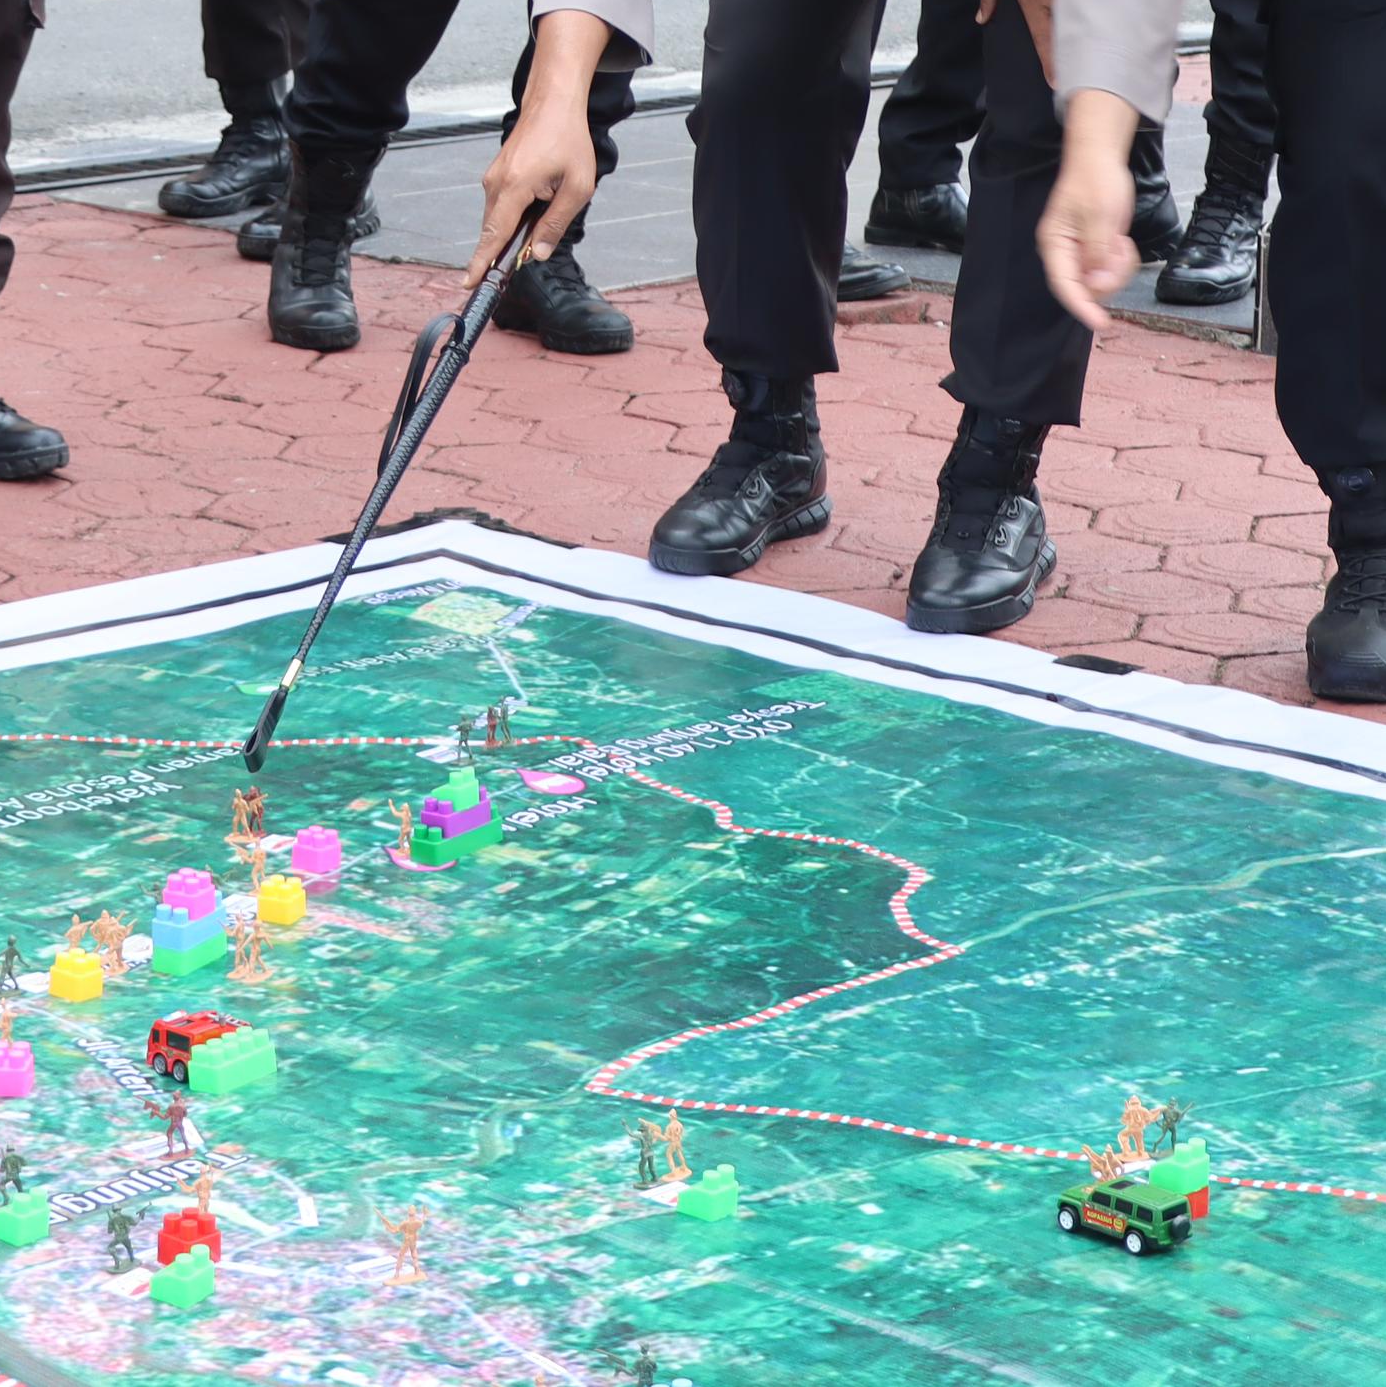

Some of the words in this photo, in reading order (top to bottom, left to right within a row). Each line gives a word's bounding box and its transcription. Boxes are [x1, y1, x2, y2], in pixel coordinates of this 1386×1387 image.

[620, 720, 730, 756] Tanjung
[727, 717, 793, 742] OYO
[147, 744, 247, 776] aman
[548, 744, 621, 770] Balai
[576, 745, 662, 784] Hotel
[25, 768, 155, 806] Pesona
[505, 795, 598, 829] Hotel
[49, 1150, 254, 1217] Tanjung
